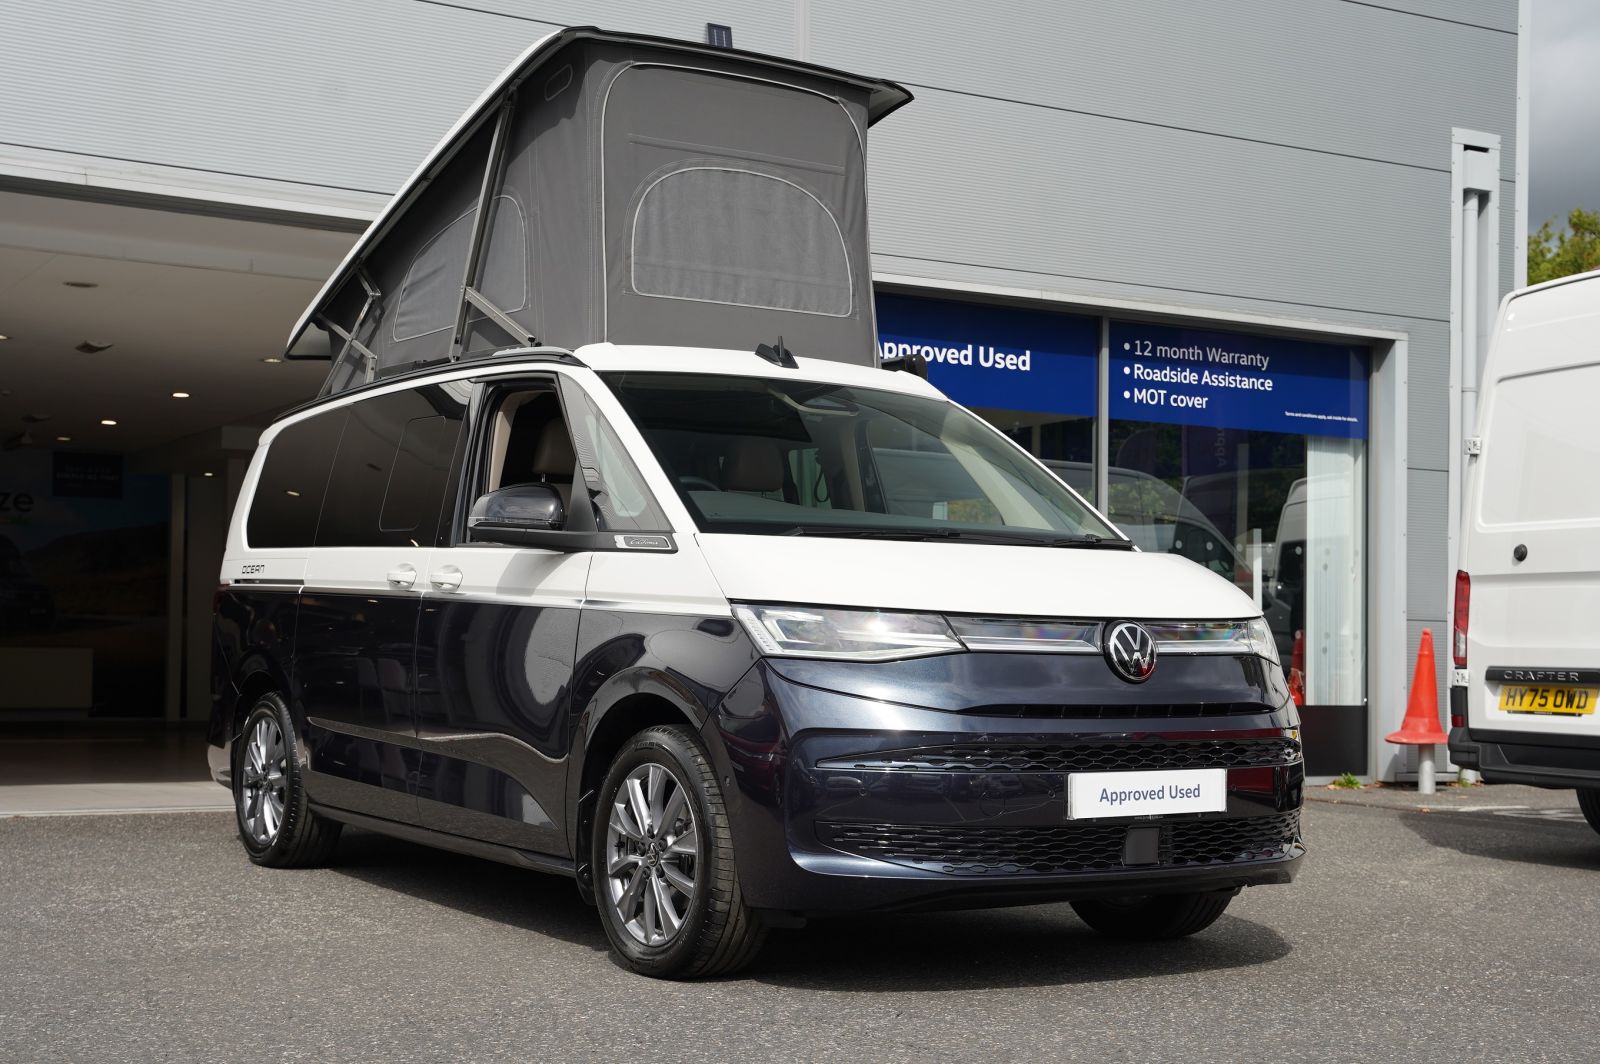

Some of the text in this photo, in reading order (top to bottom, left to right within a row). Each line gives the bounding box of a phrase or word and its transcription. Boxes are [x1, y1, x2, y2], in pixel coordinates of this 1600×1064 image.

[979, 345, 1031, 371] Used
[1134, 340, 1270, 371] 12 month Warranty
[1134, 364, 1273, 391] Roadside Assistance
[1134, 388, 1208, 409] MOT cover
[242, 564, 265, 574] OCEAN
[1503, 670, 1580, 682] CRAFTER
[1505, 687, 1550, 708] HY75
[1100, 784, 1201, 805] Approved Used
